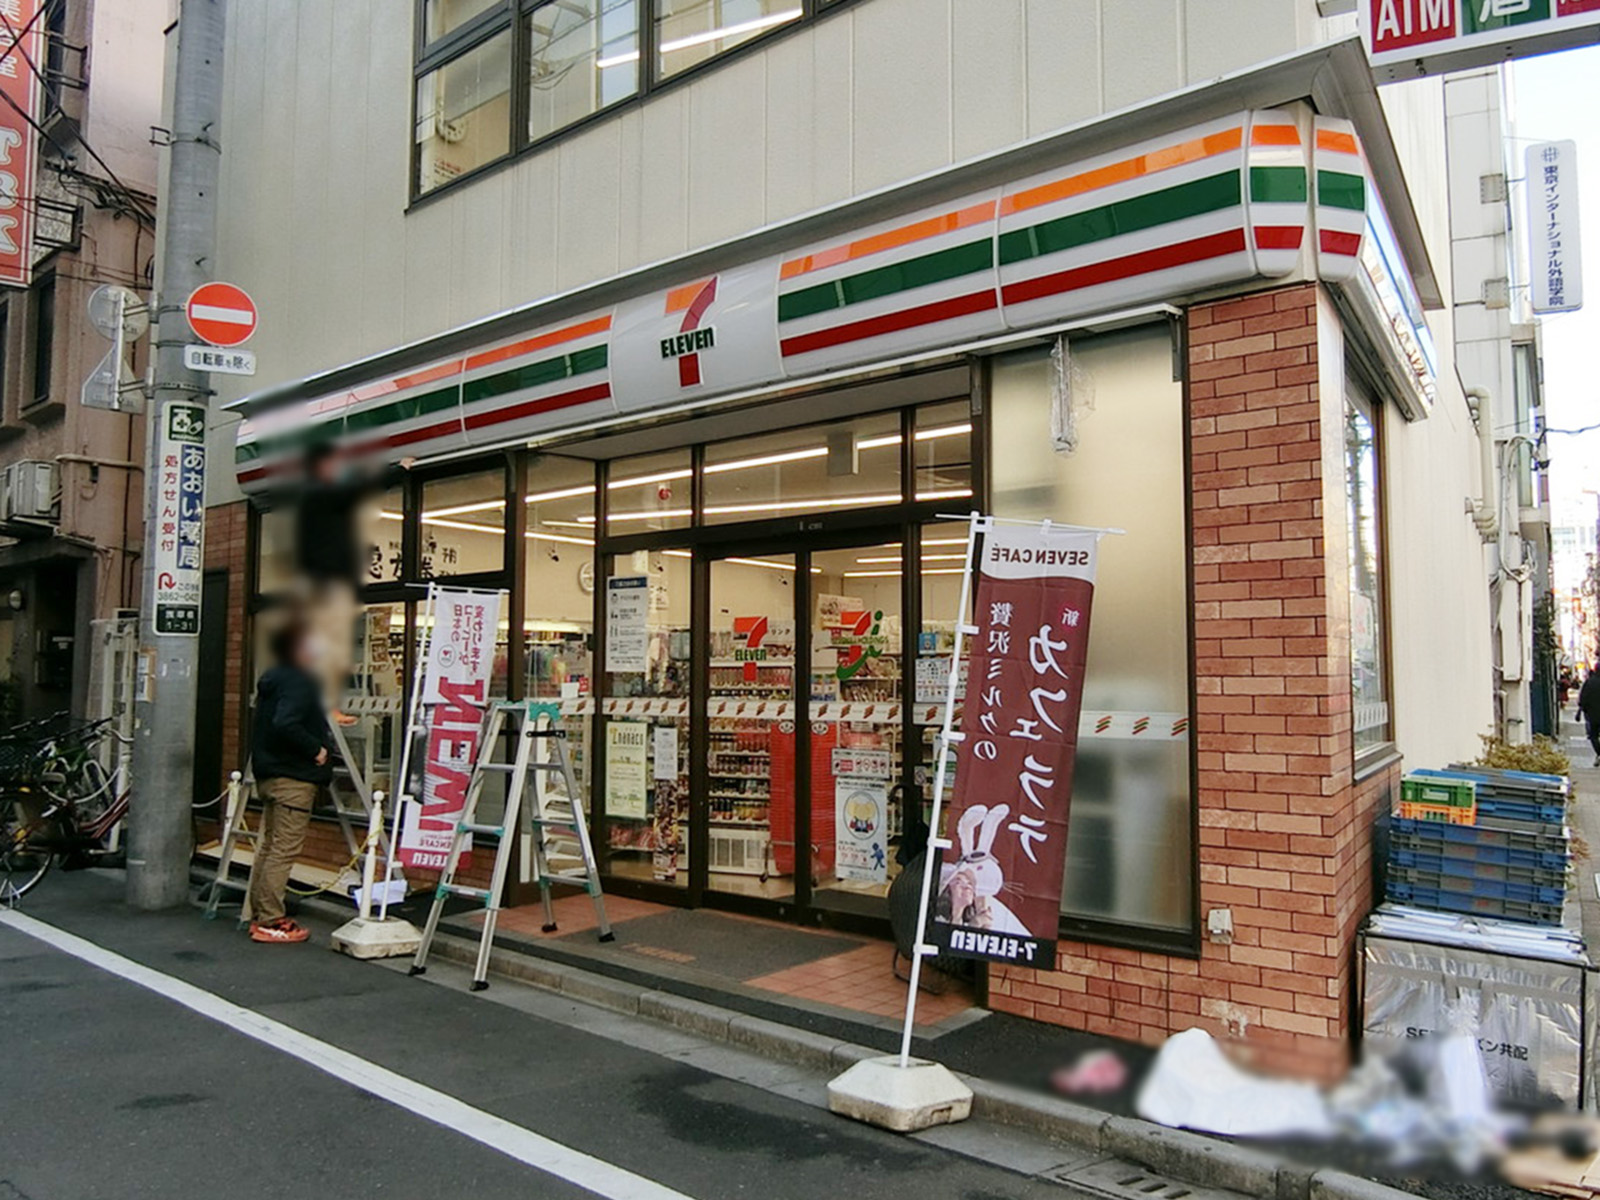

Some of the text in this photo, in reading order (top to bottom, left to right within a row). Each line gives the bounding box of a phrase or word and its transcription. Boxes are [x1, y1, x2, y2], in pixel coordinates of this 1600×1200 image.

[161, 455, 178, 552] 処方せん受付
[178, 447, 204, 568] あおい薬局
